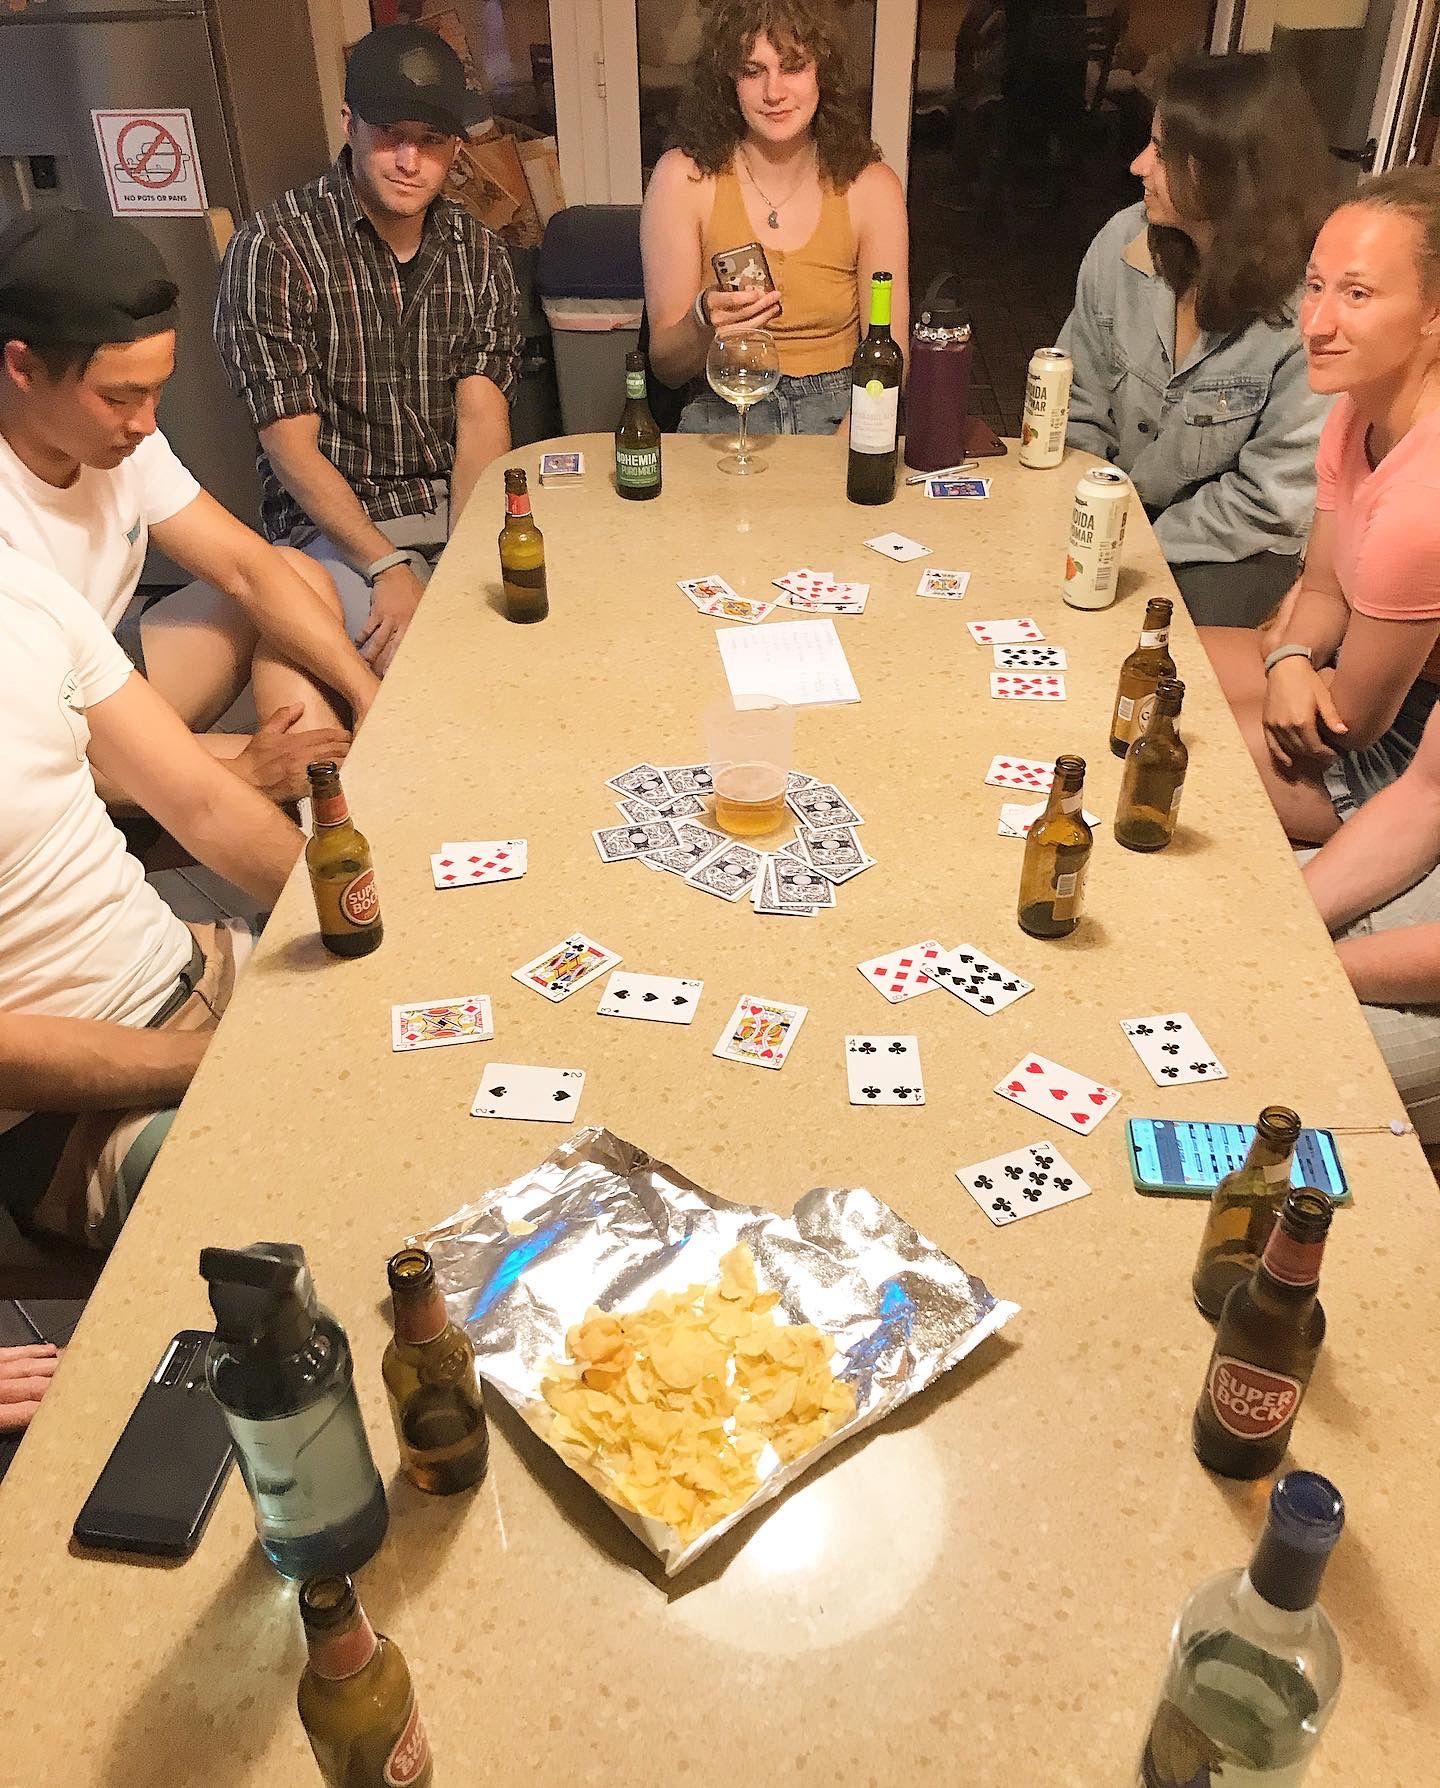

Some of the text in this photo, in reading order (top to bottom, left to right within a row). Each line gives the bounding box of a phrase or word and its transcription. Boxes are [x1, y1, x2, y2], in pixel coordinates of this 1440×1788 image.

[616, 450, 658, 467] BOHEMIA
[348, 880, 376, 905] SUPE
[1216, 1384, 1287, 1421] BOCK
[1218, 1366, 1295, 1408] SUPER
